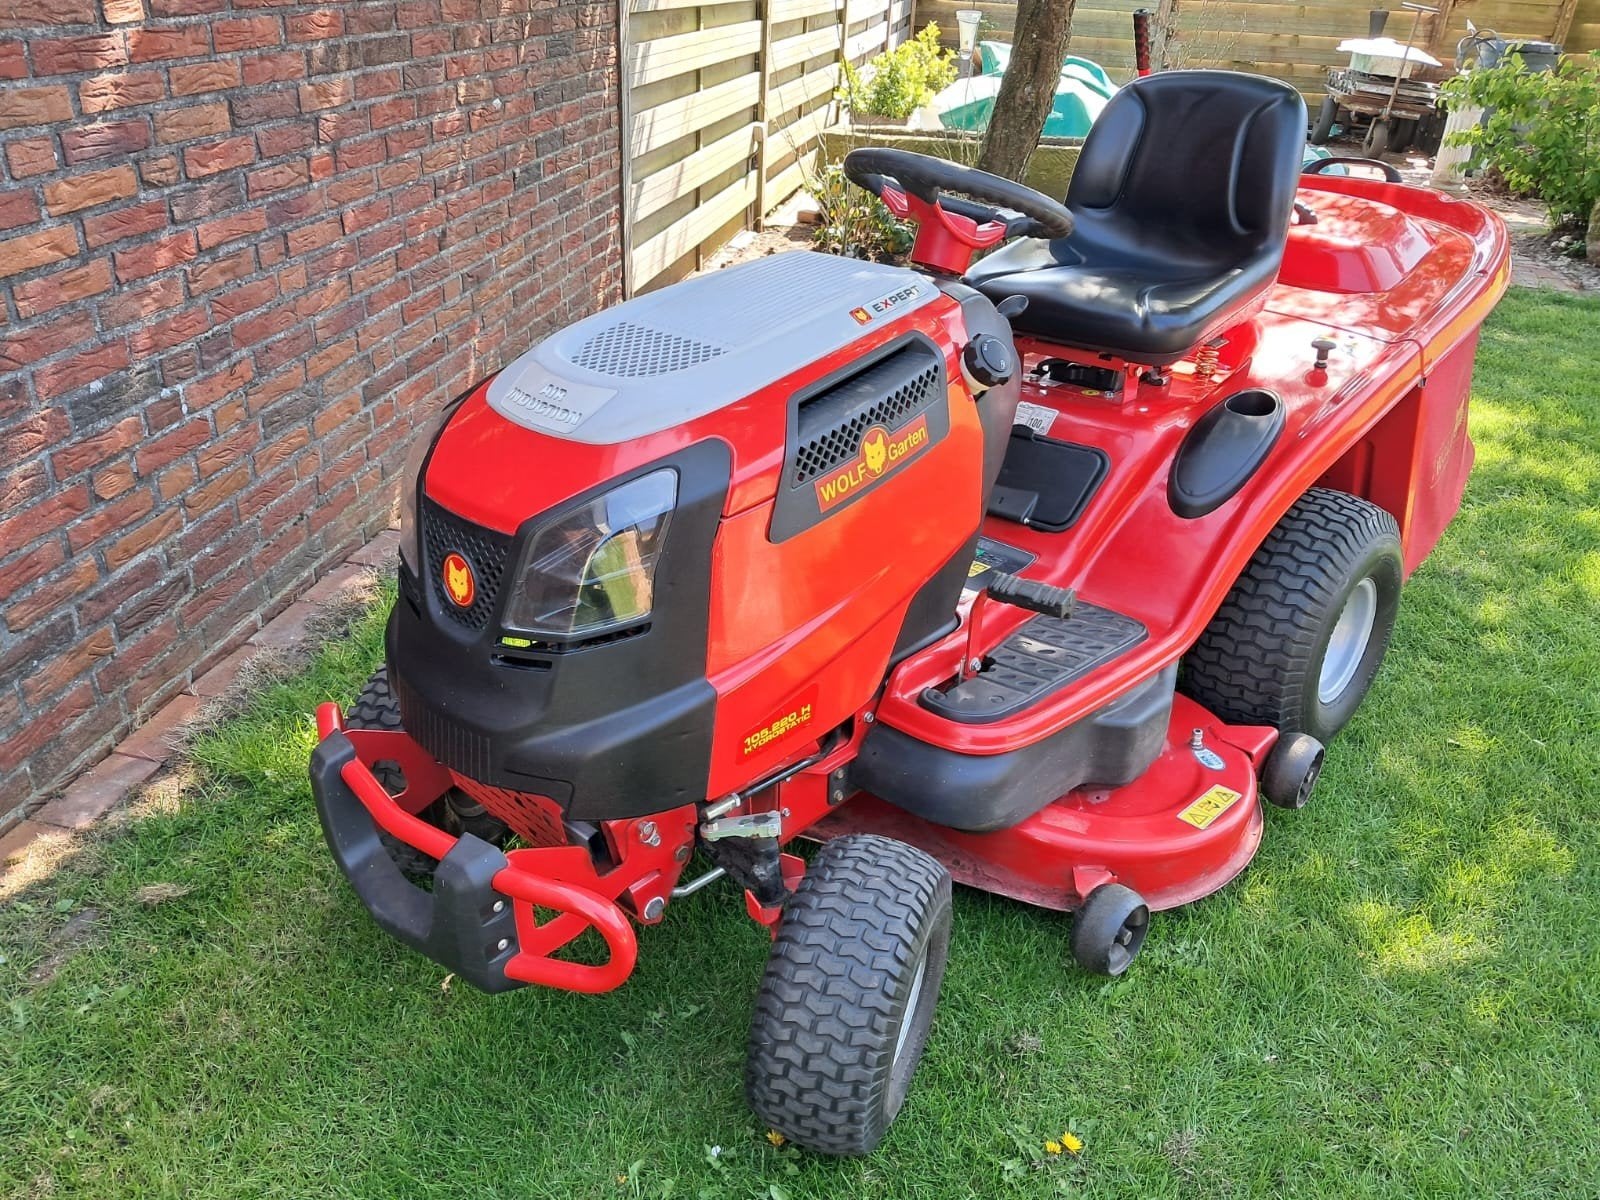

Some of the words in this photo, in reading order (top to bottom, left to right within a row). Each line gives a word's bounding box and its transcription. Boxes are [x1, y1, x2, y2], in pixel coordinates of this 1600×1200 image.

[872, 285, 920, 312] EXPERT
[506, 386, 583, 425] INDUCTION
[539, 383, 568, 401] AIR
[1029, 417, 1043, 429] 100
[820, 462, 866, 502] WOLF
[888, 426, 926, 461] Garten
[744, 712, 797, 746] 105.220
[801, 704, 811, 715] H
[744, 712, 811, 755] HYDROSTATIC
